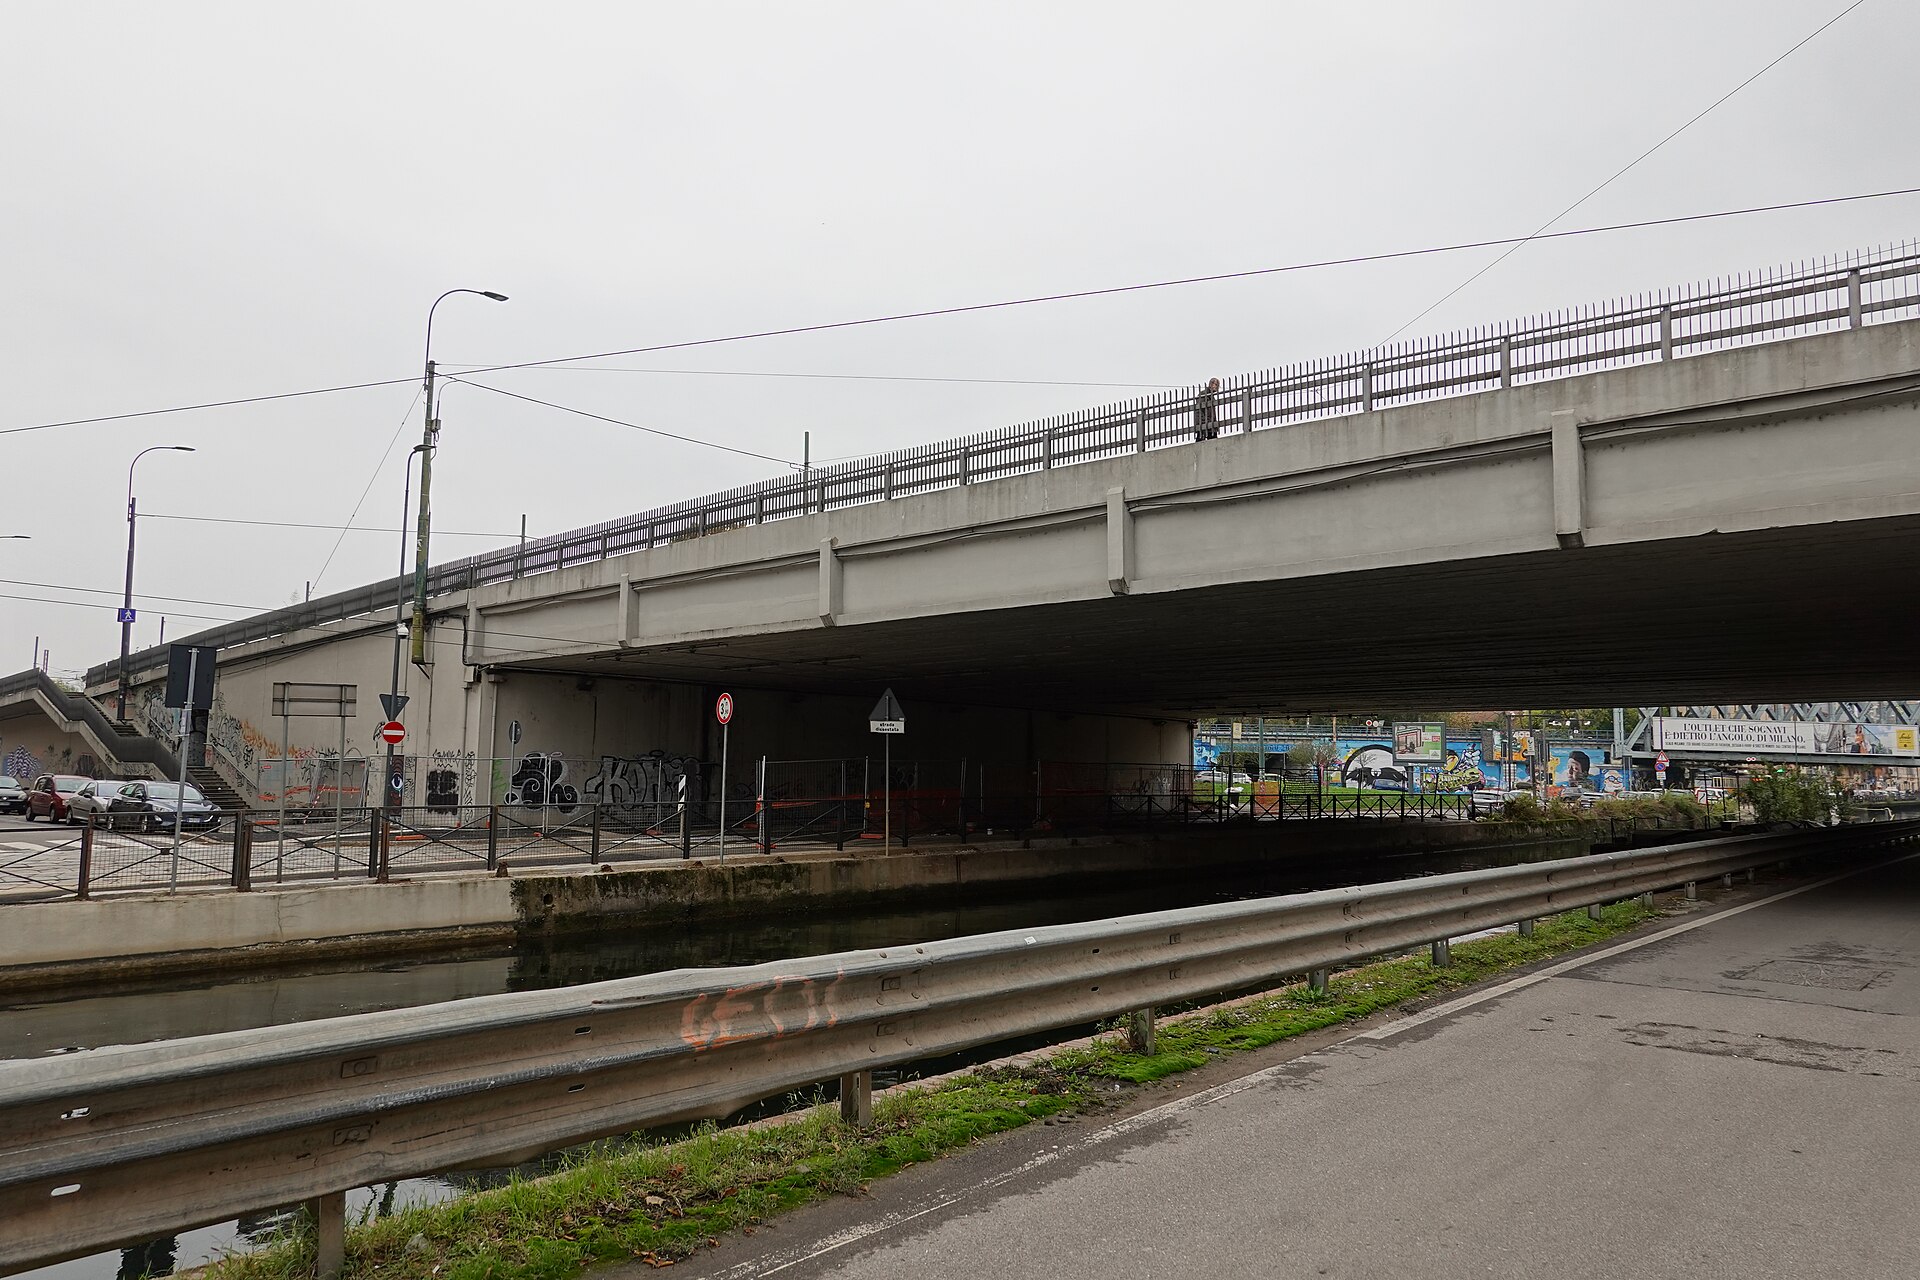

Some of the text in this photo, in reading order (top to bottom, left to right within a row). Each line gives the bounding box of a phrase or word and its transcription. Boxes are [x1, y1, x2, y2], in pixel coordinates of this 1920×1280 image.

[1683, 724, 1786, 734] L'OUTLET CHE SOGNAVI
[1673, 732, 1707, 741] DIETRO
[1709, 732, 1755, 742] L'ANGOLO.
[1757, 734, 1767, 742] DI
[1769, 735, 1806, 744] MILANO.
